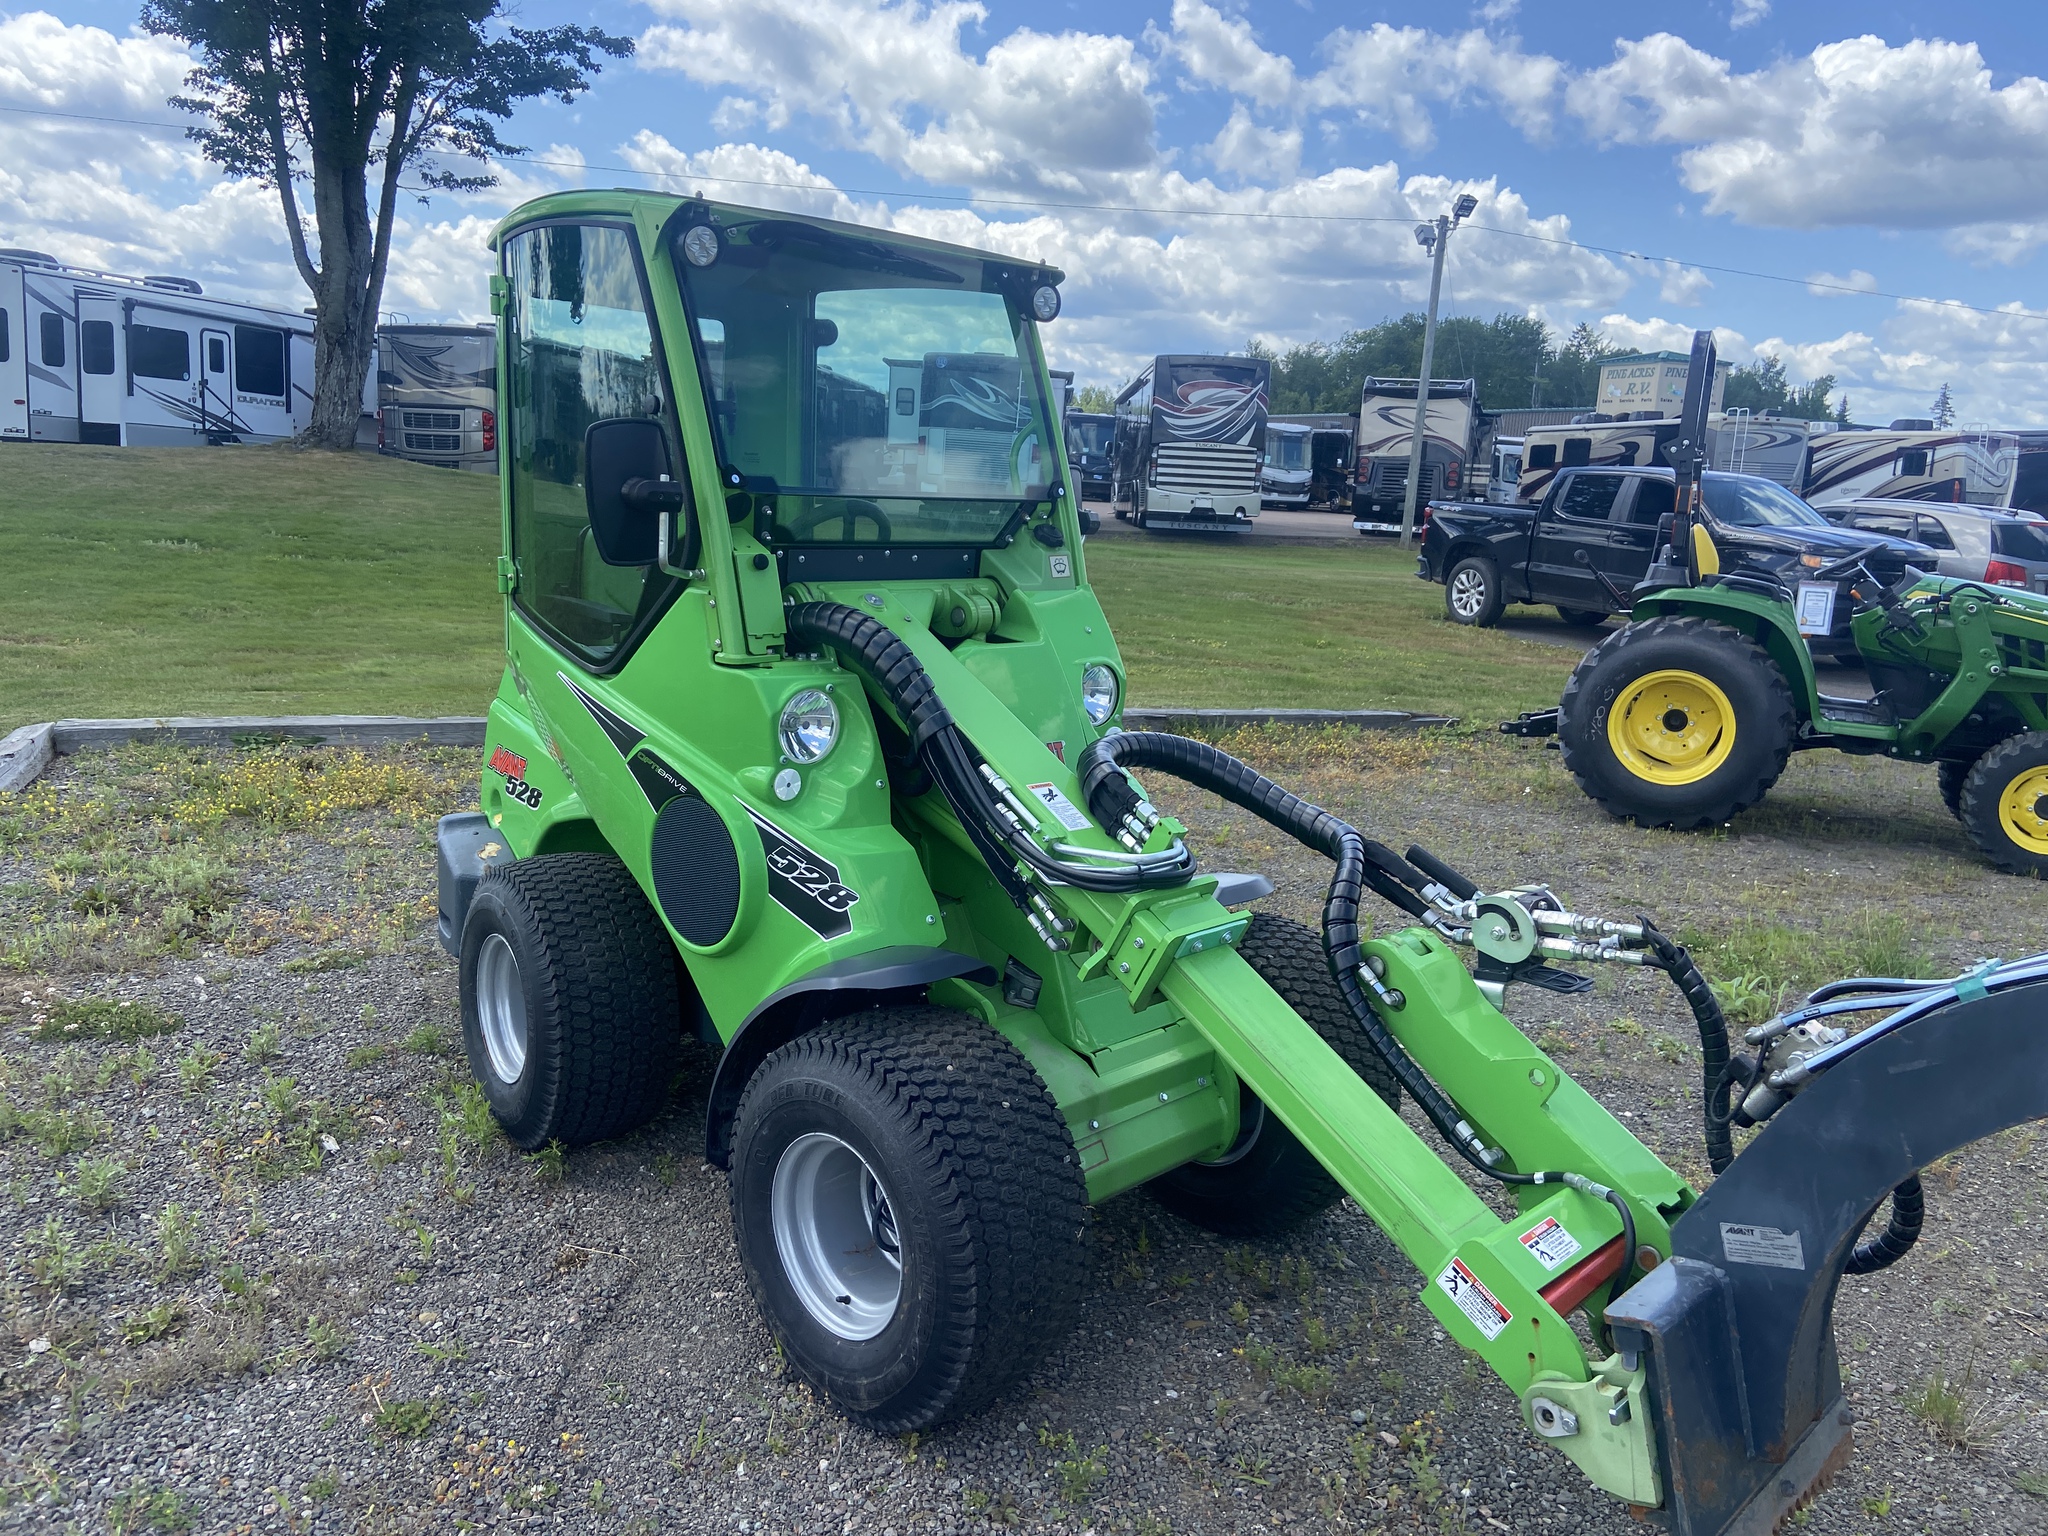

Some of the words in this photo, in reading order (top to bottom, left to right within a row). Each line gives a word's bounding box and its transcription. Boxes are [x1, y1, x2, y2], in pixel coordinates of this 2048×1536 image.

[1606, 369, 1628, 379] PINE
[1627, 368, 1655, 378] ACRES
[1665, 367, 1689, 378] PINE
[1625, 382, 1651, 395] R.V.
[1169, 522, 1229, 531] TUSCANY
[487, 743, 527, 780] AVANT
[505, 775, 543, 811] 528
[766, 845, 860, 912] 528
[1725, 1226, 1755, 1237] AVANT
[1473, 1280, 1499, 1307] DANGER
